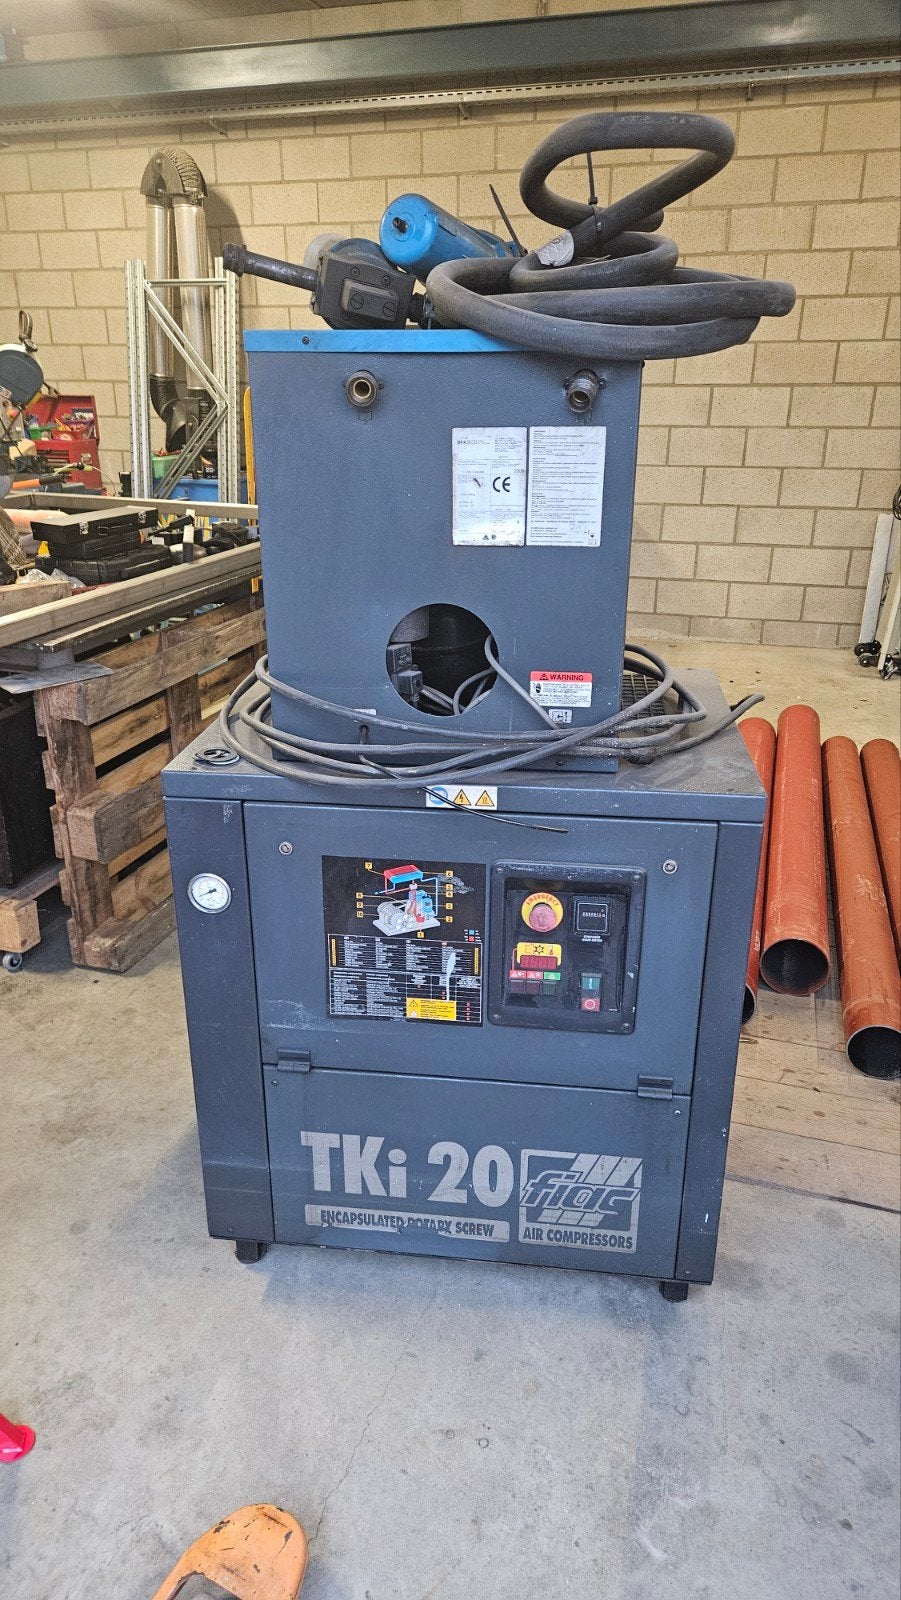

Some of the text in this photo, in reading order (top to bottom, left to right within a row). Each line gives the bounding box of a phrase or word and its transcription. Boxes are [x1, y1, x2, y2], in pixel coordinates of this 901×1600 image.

[492, 476, 510, 492] CE
[526, 894, 559, 906] EMERGENCY
[300, 1131, 514, 1207] TKi 20
[320, 1209, 404, 1228] ENCAPSULATED
[455, 1221, 494, 1236] SCREW
[523, 1227, 633, 1249] AIR COMPRESSORS
